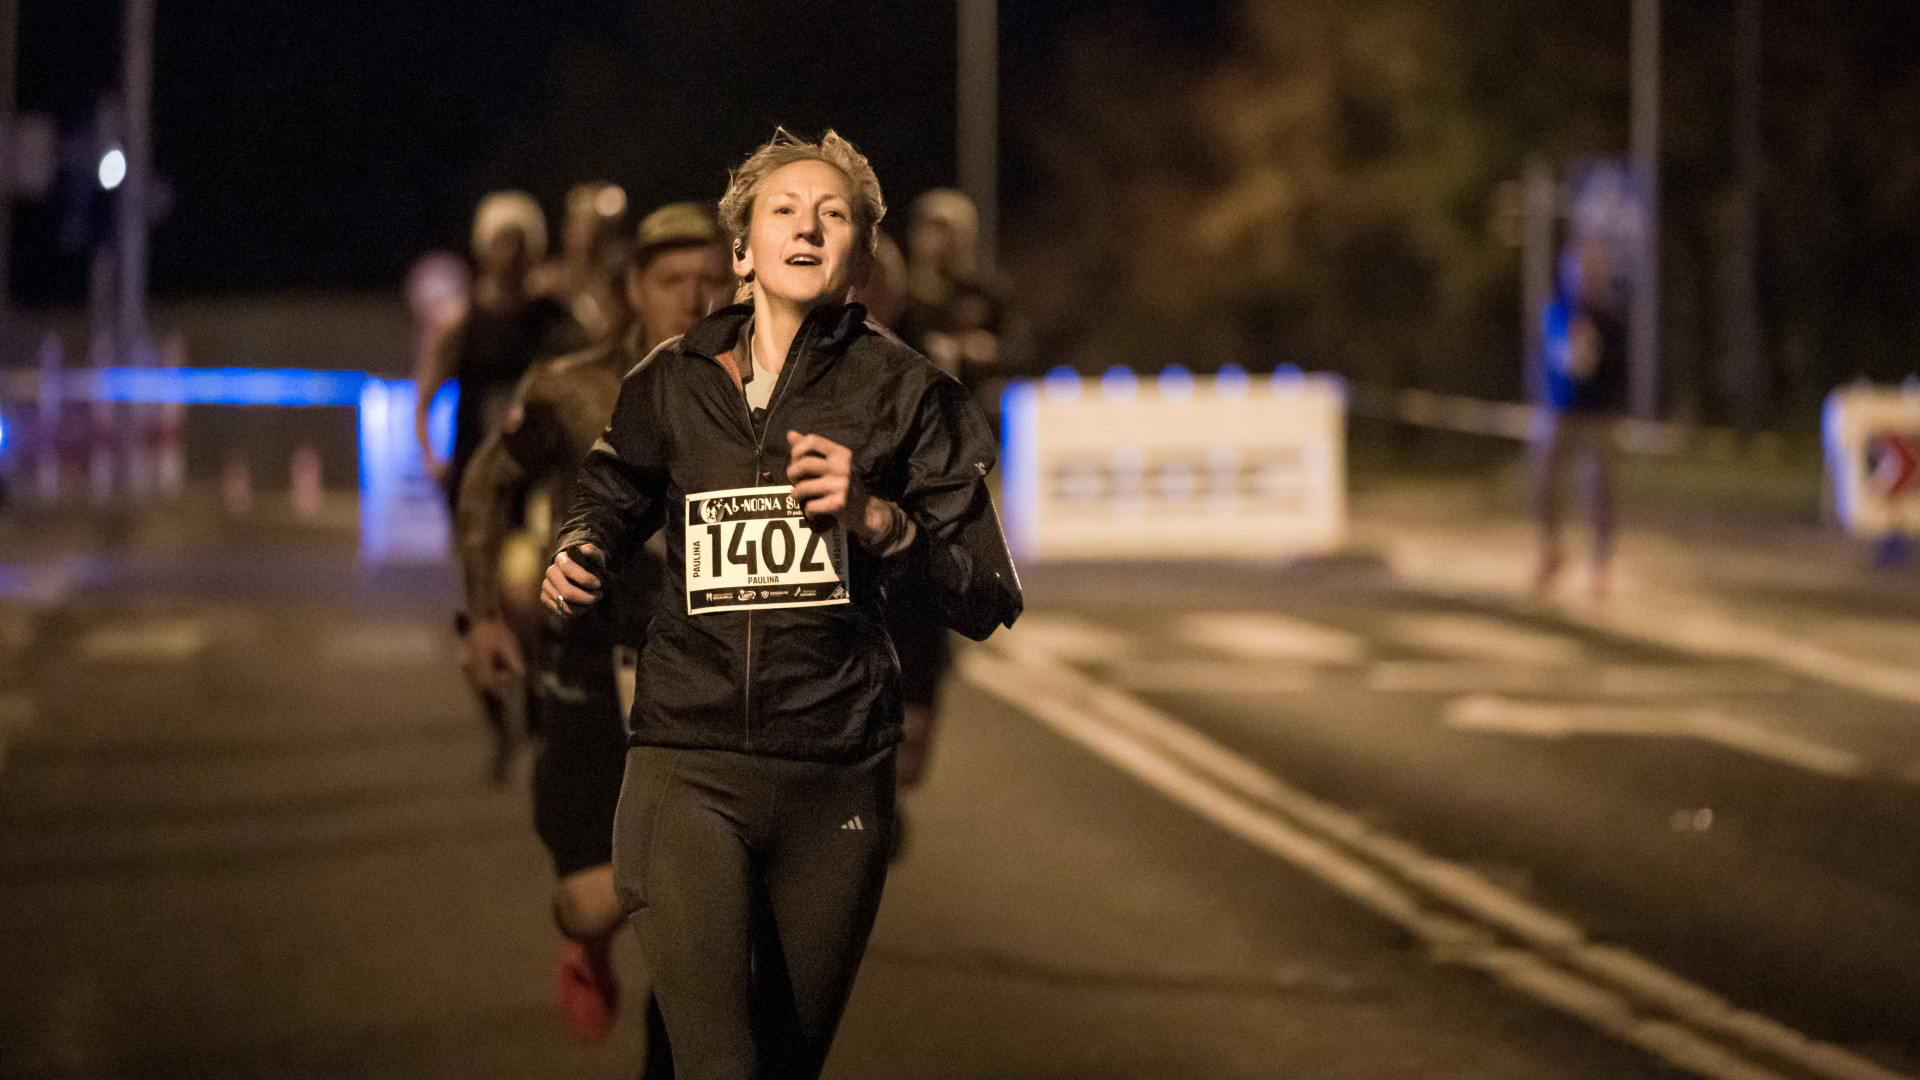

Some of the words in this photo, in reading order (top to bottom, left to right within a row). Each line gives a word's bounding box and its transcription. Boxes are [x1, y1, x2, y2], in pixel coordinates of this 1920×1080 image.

[743, 497, 781, 512] NOCNA
[693, 540, 701, 578] PAULINA
[707, 520, 825, 578] 1402
[748, 576, 779, 585] PAULINA
